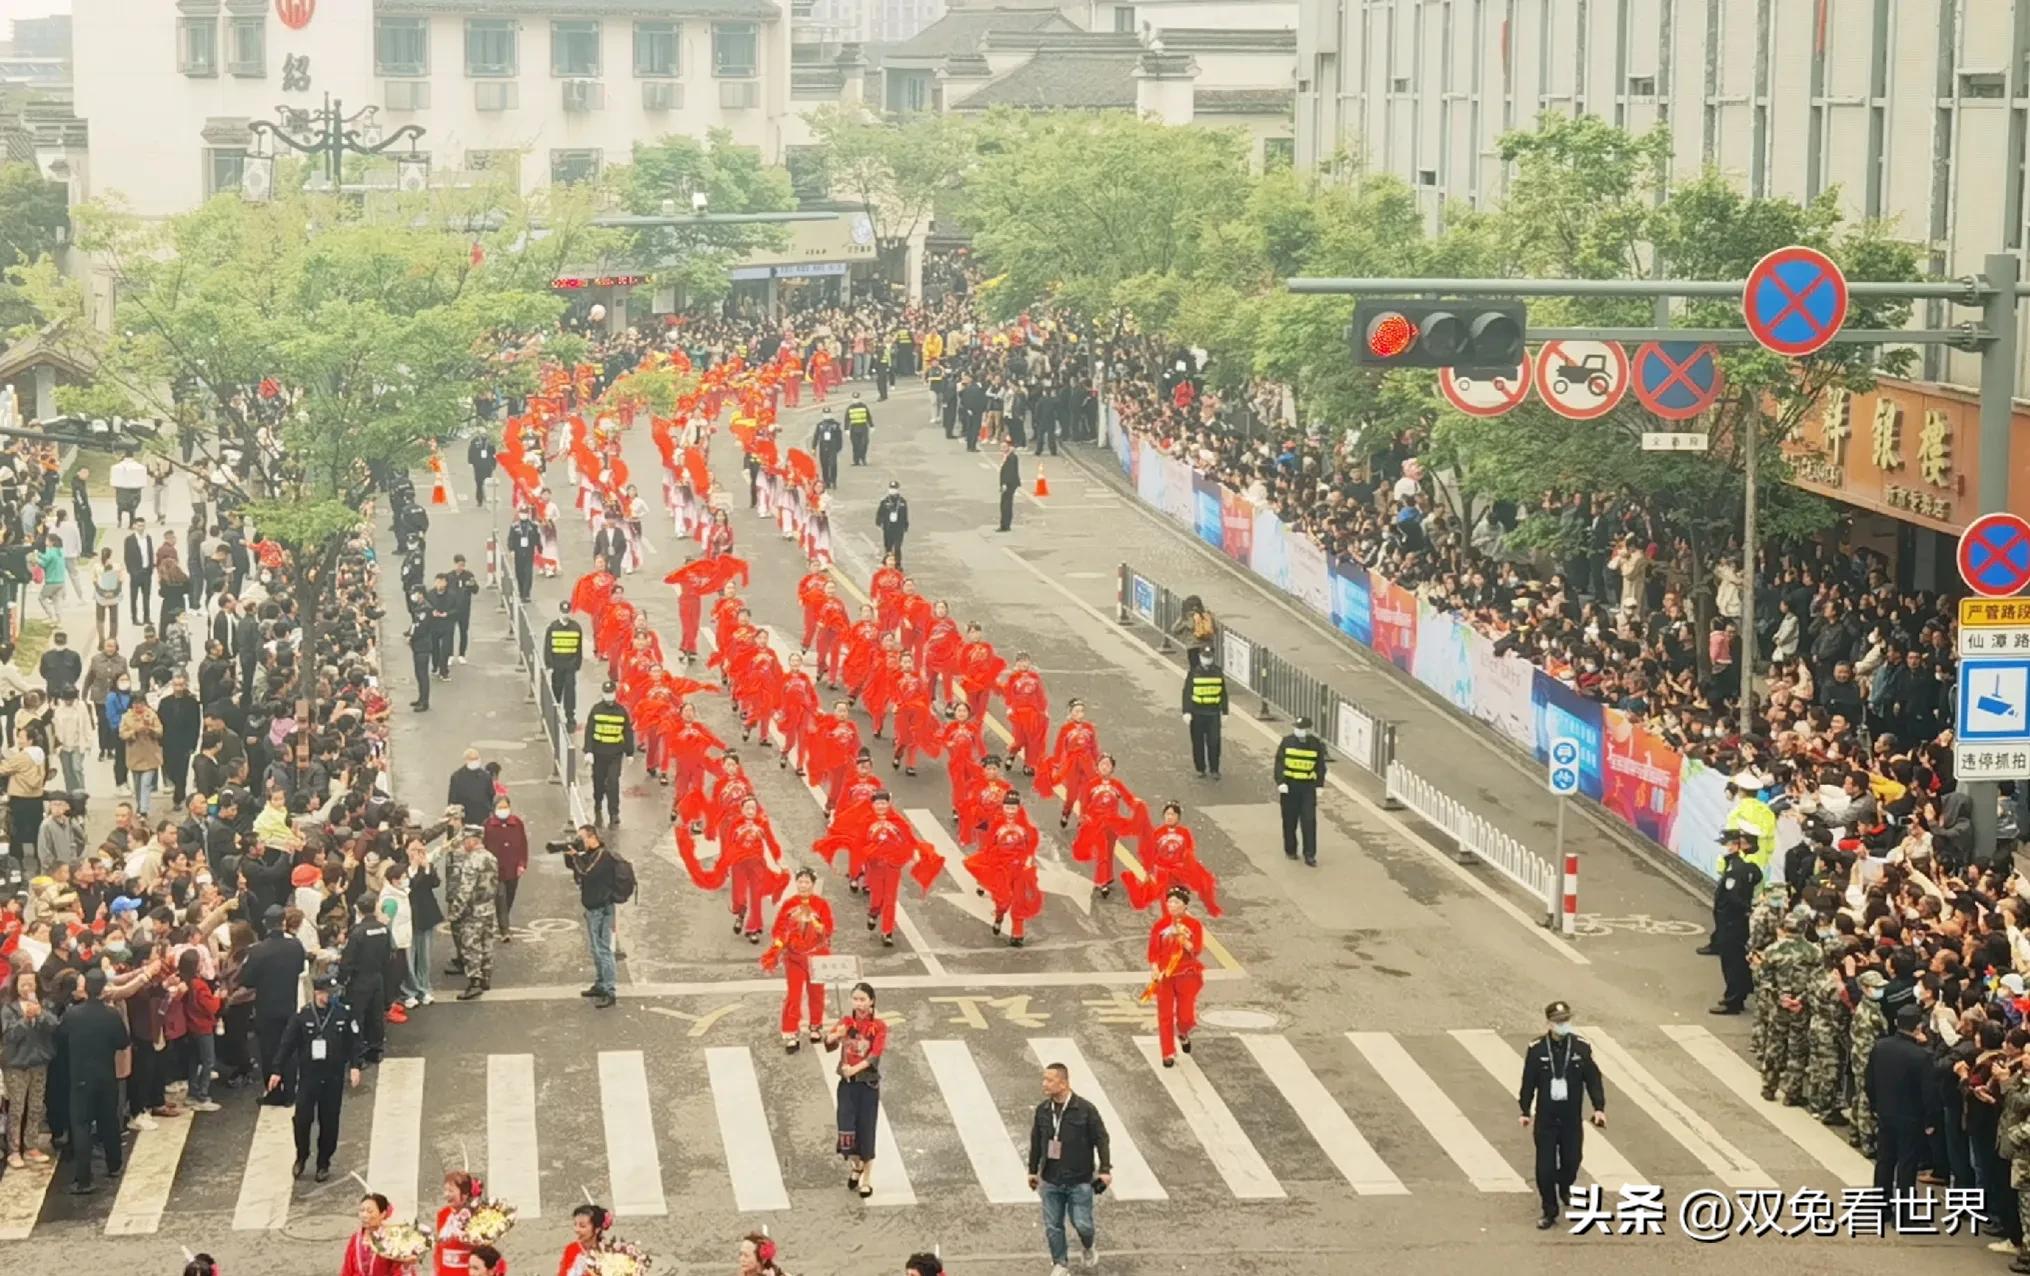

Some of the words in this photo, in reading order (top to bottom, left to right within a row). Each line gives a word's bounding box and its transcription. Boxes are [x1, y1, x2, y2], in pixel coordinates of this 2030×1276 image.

[1967, 604, 2030, 621] 严管路段
[1968, 634, 2030, 649] 仙潭路
[1961, 753, 2026, 771] 违停抓拍
